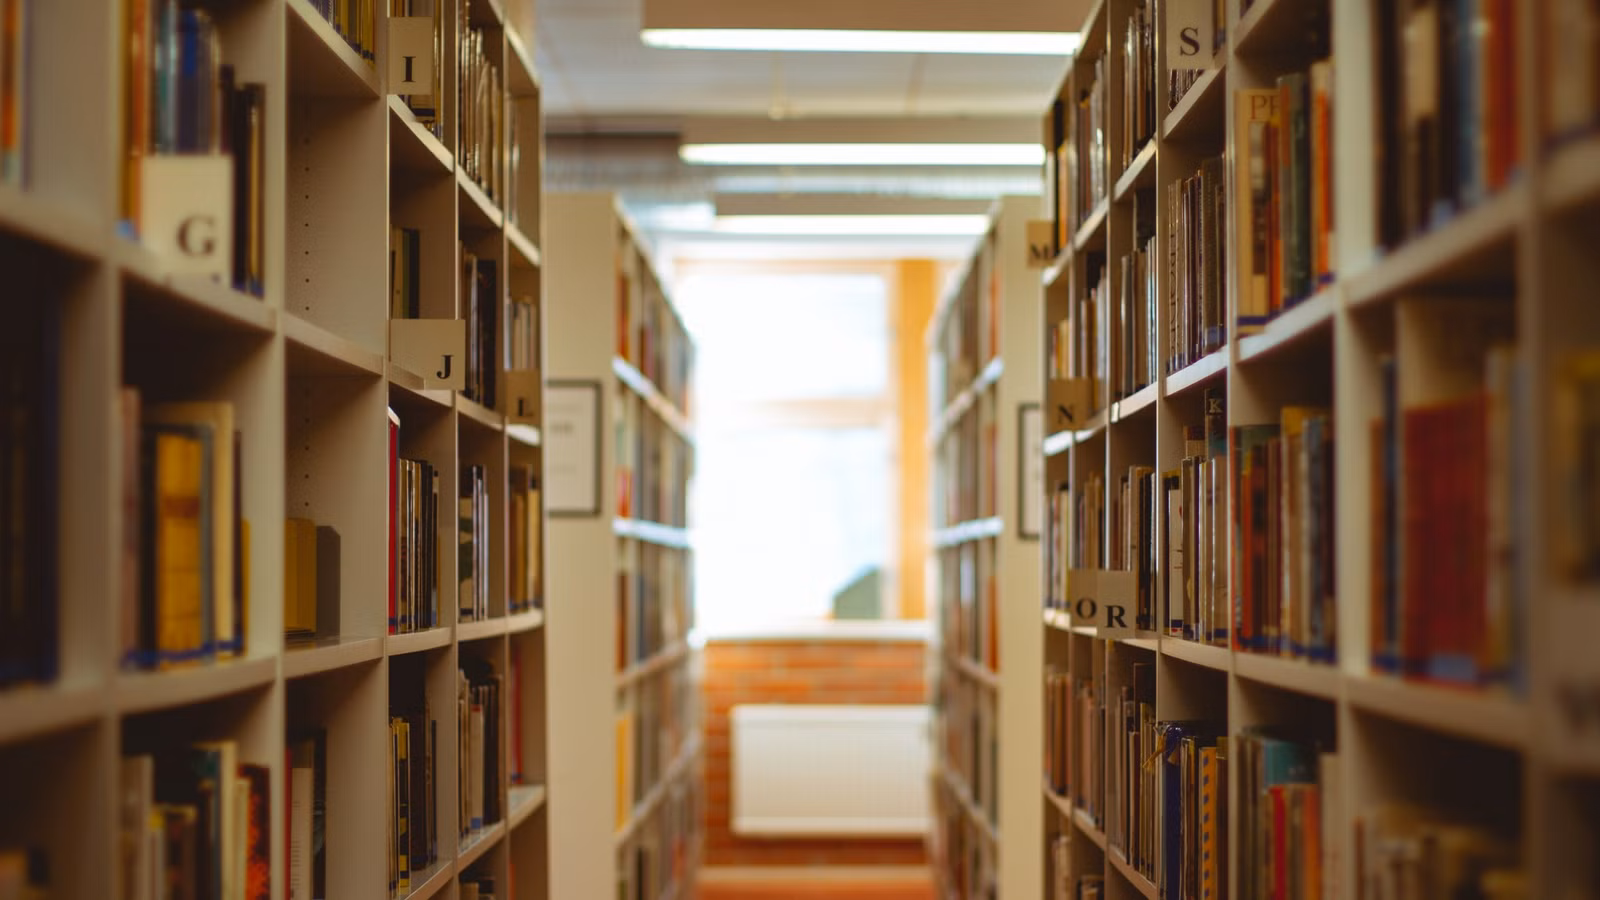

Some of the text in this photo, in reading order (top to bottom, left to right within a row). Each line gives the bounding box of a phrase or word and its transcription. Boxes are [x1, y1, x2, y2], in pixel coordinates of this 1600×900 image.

[1180, 27, 1200, 56] S
[401, 55, 416, 83] I
[176, 214, 215, 259] G
[436, 354, 455, 380] J
[1057, 403, 1076, 425] N
[1209, 398, 1223, 413] K
[1076, 597, 1097, 620] O
[1104, 604, 1128, 628] R
